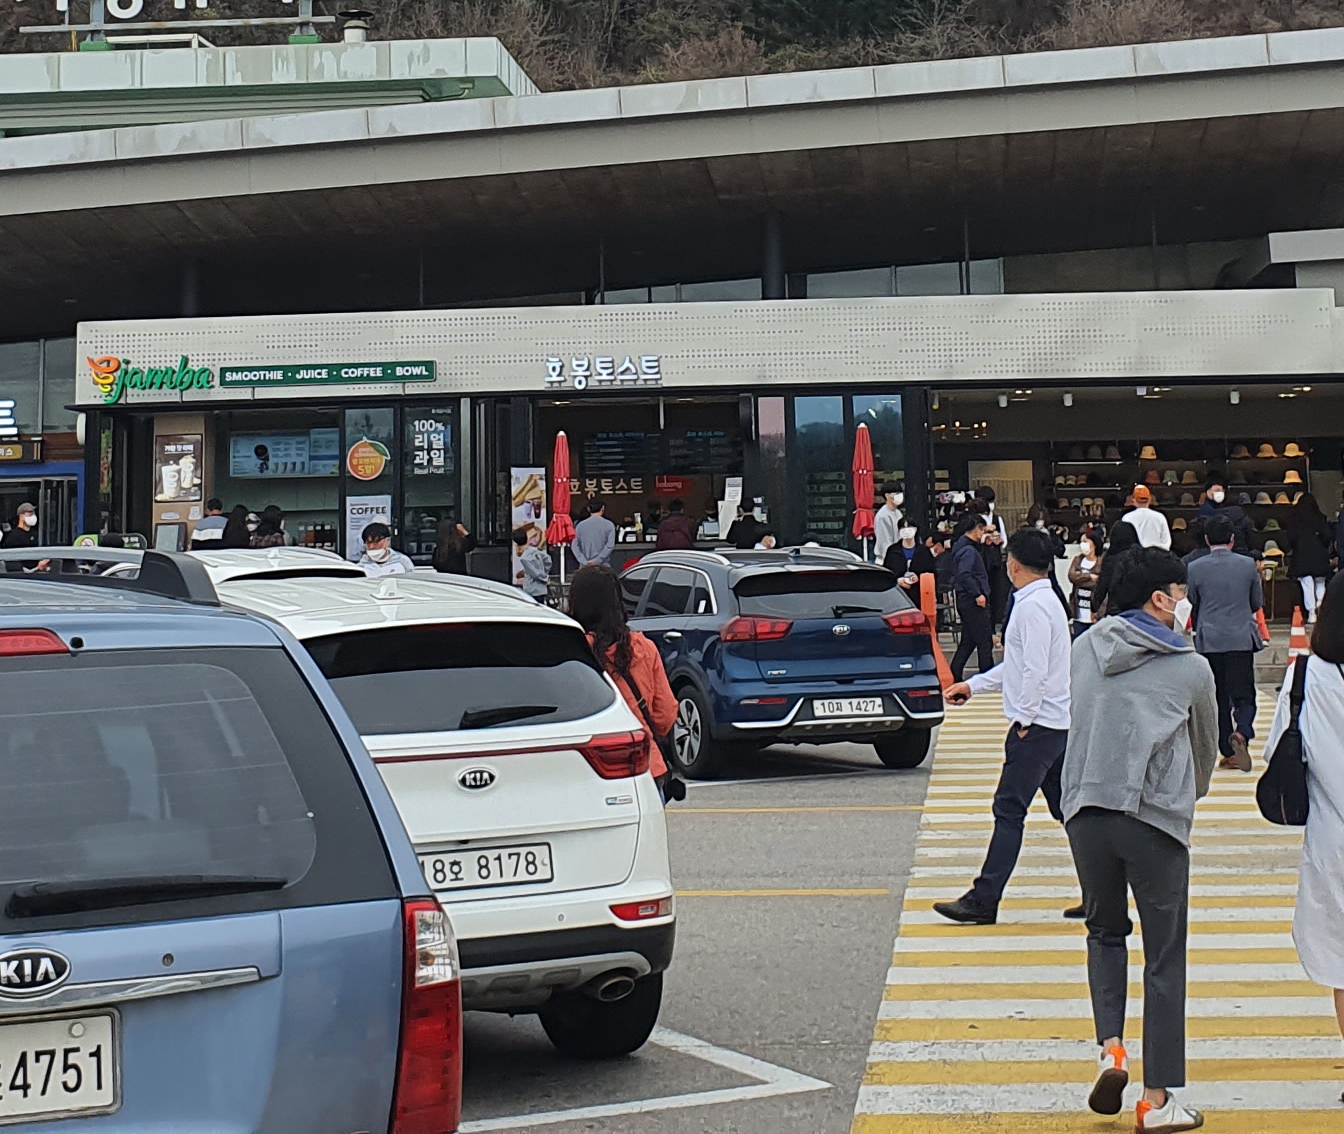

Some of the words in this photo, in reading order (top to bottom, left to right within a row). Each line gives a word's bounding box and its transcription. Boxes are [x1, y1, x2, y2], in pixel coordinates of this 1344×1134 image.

[103, 355, 214, 404] jamba
[225, 370, 284, 382] SMOOTHIE
[295, 369, 329, 379] JUICE
[341, 367, 384, 378] COFFEE
[395, 366, 429, 376] BOWL
[544, 355, 662, 390] 호봉토스트
[413, 419, 445, 432] 100%
[414, 433, 444, 450] 리얼
[413, 450, 444, 466] 과일
[570, 478, 644, 500] 호봉토스트
[350, 506, 387, 515] COFFEE
[848, 699, 876, 713] 1427
[465, 772, 492, 786] KIA
[477, 850, 539, 881] 8178
